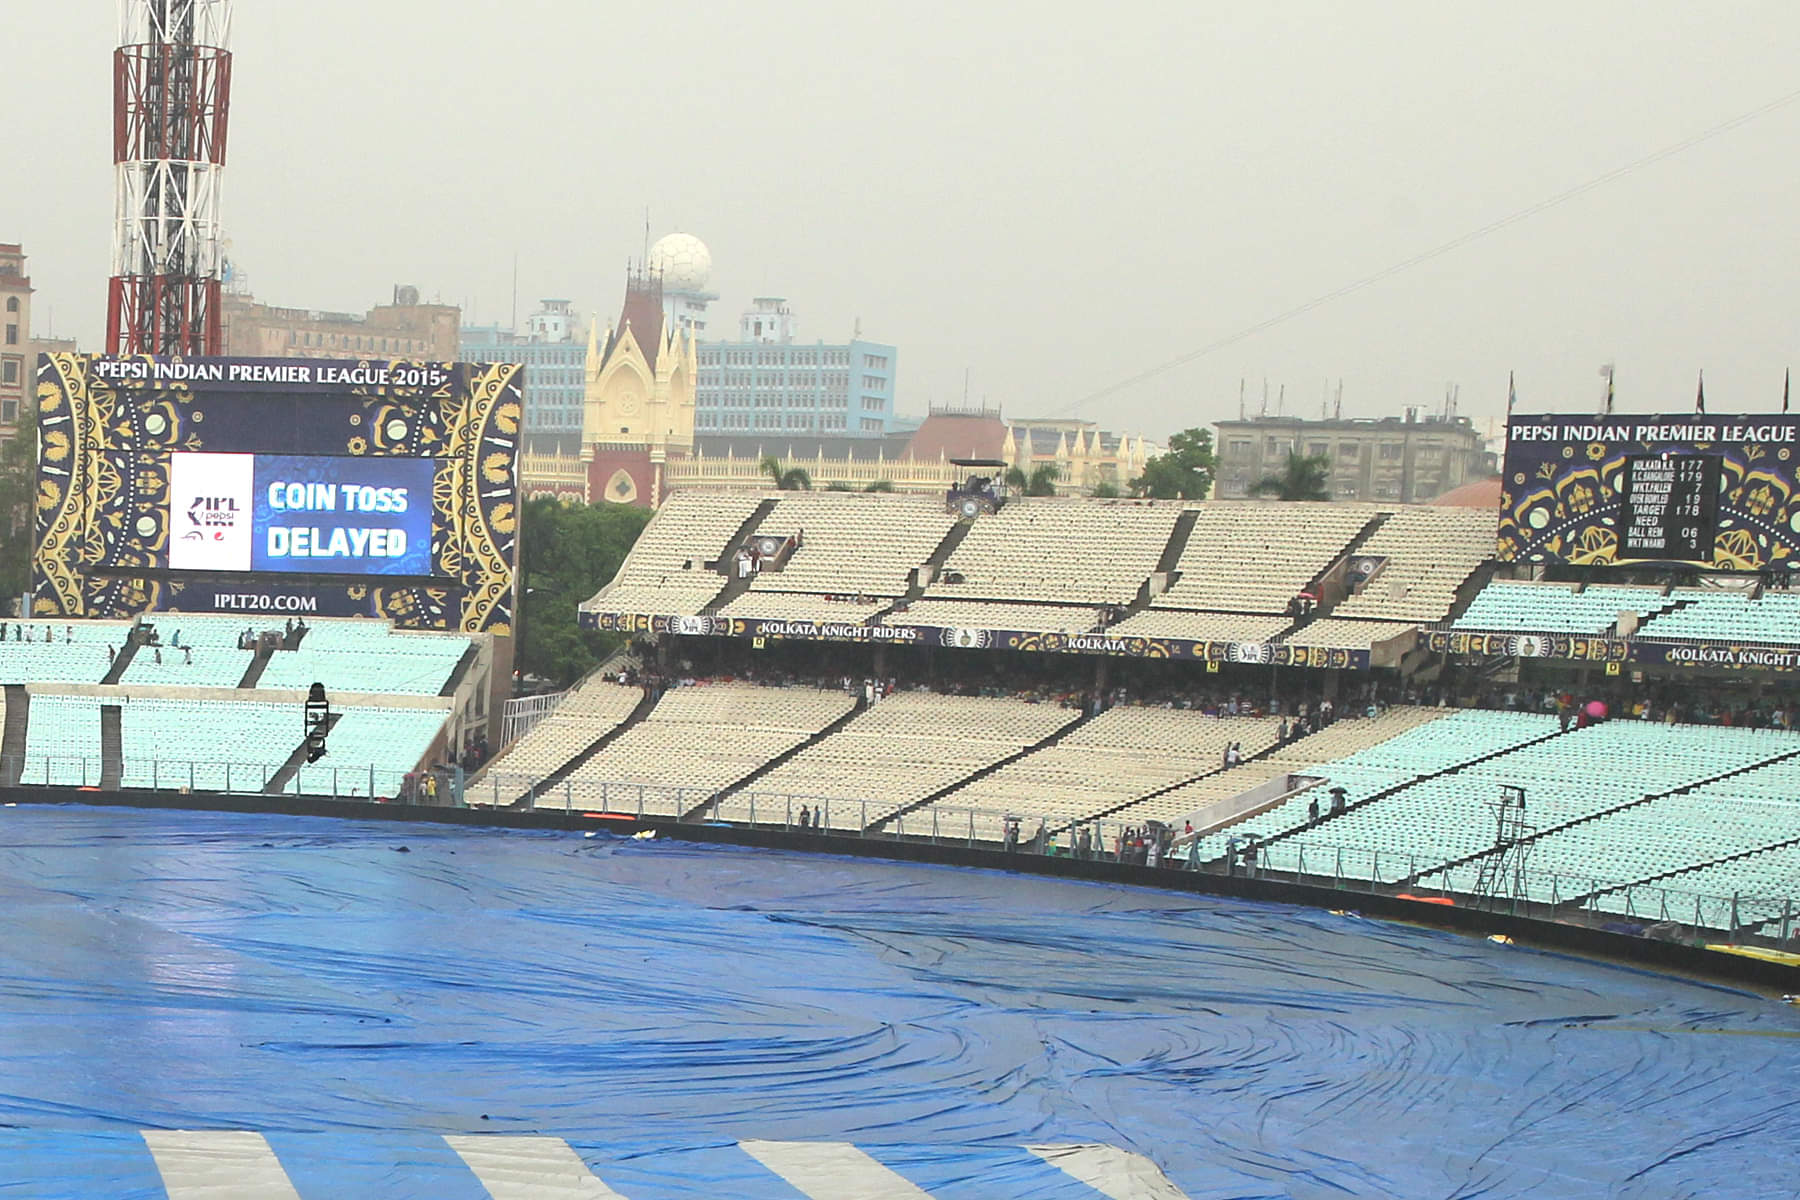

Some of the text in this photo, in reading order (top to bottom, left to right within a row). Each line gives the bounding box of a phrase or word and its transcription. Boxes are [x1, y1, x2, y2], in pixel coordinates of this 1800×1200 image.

[99, 361, 441, 386] PEPSI INDIAN PREMIER LEAGUE 2015
[1511, 425, 1796, 442] PEPSI INDIAN PREMIER LEAGUE
[1680, 460, 1703, 470] 177
[1680, 471, 1702, 482] 179
[1695, 483, 1702, 493] 7
[267, 481, 408, 513] COIN TOSS
[1686, 494, 1701, 504] 19
[1633, 505, 1700, 516] TARGET 178
[1635, 515, 1658, 526] NEED
[1628, 527, 1645, 537] BALL
[1681, 527, 1698, 538] 06
[267, 526, 408, 557] DELAYED
[1689, 539, 1697, 549] 3
[214, 593, 317, 611] IPLT20.COM
[761, 622, 916, 639] KOLKATA KNIGHT RIDERS
[1068, 638, 1126, 650] KOLKATA
[1671, 648, 1794, 667] KOLKATA KNIGHT
